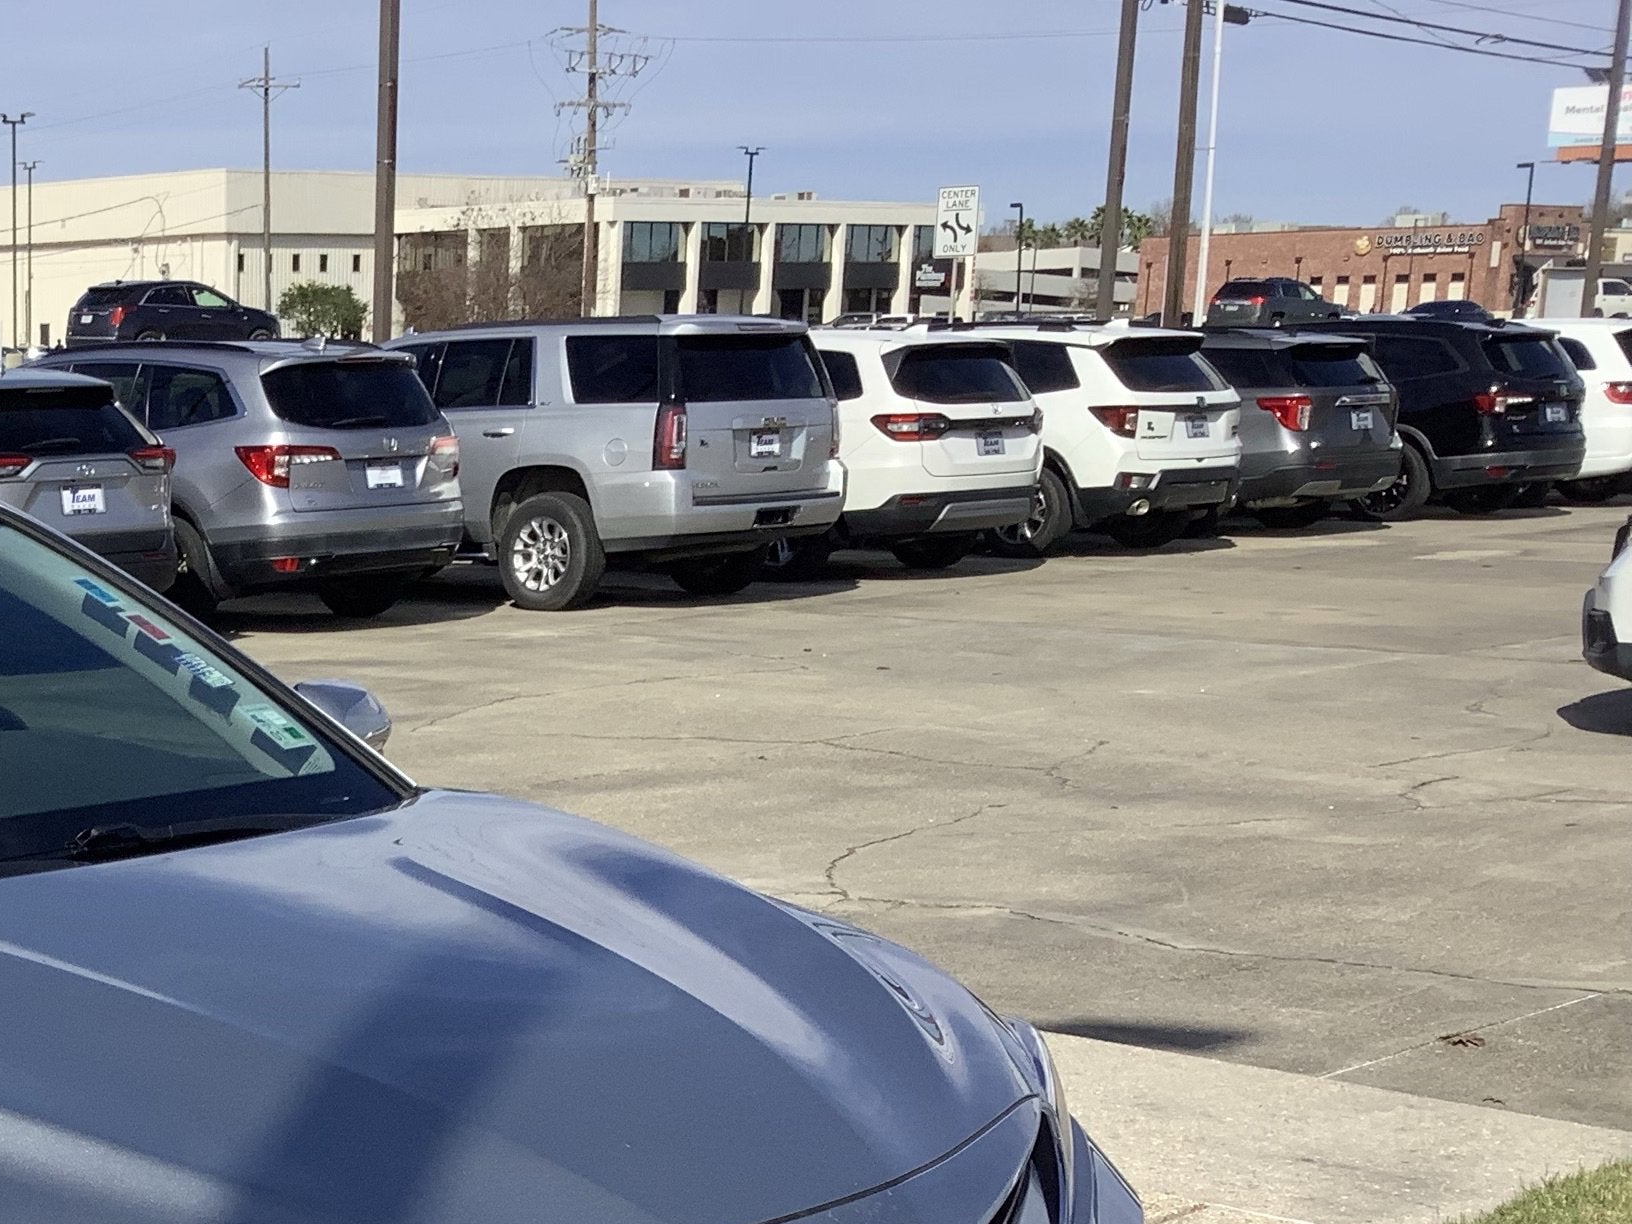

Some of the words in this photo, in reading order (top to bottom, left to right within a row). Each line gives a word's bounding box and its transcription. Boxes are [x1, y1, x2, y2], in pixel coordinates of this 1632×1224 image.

[1565, 105, 1604, 114] Mental
[942, 189, 976, 199] CENTER
[946, 200, 970, 208] LANE
[1447, 233, 1455, 245] &
[1459, 232, 1486, 245] BAO
[943, 244, 966, 253] ONLY
[70, 485, 95, 503] TEAM
